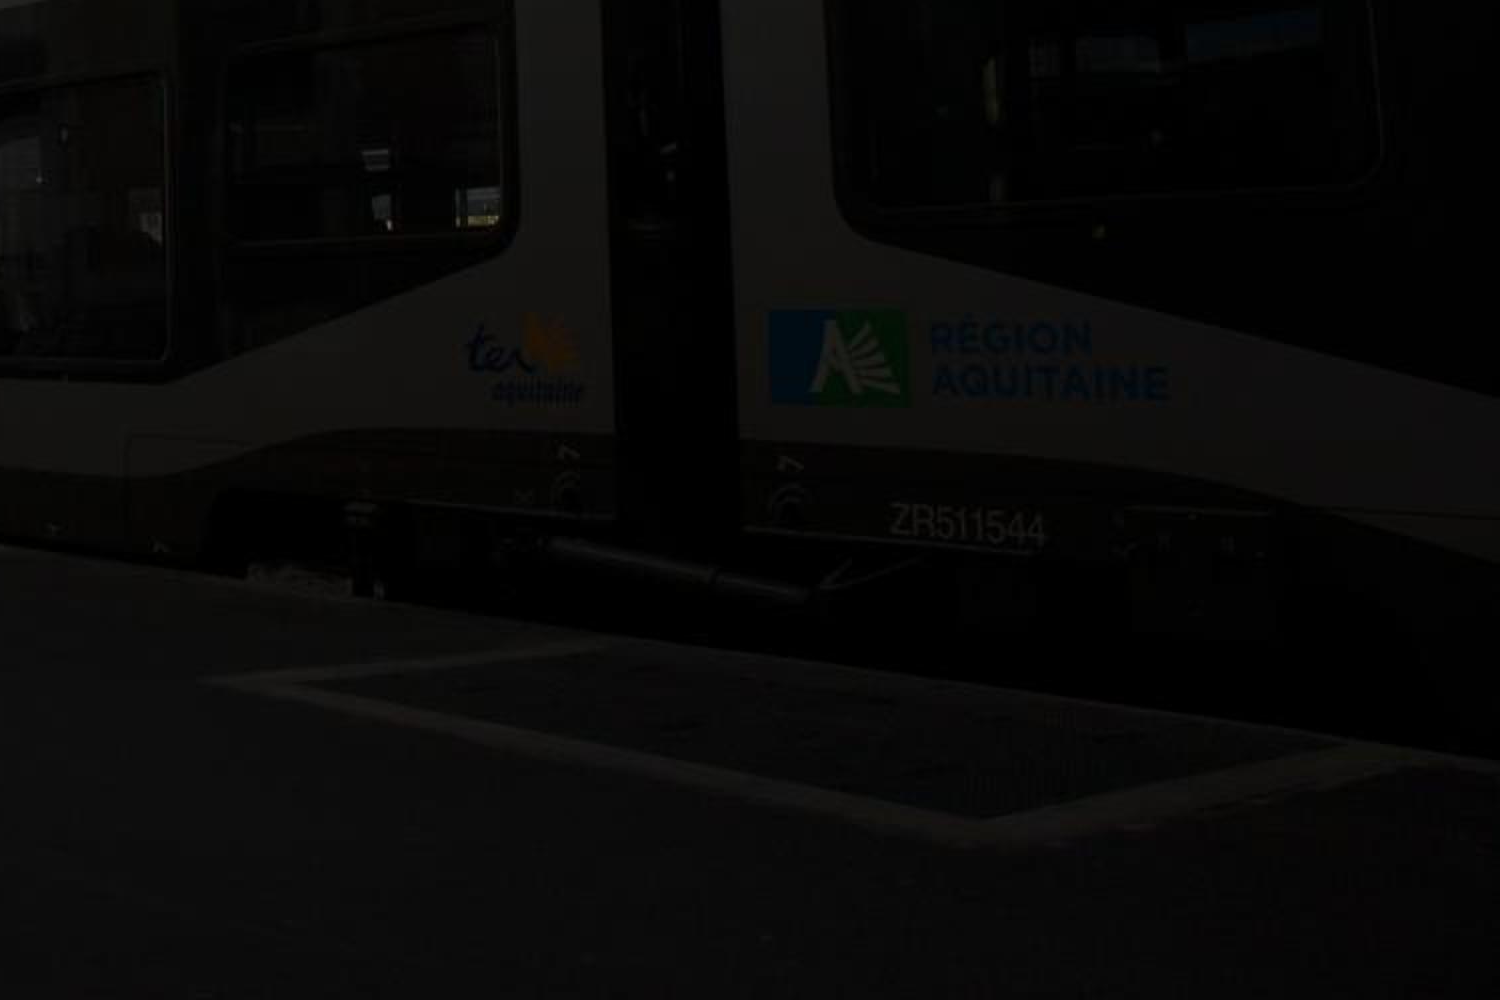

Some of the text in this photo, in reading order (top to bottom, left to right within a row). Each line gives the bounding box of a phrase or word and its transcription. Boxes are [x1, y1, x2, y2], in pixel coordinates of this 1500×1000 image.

[931, 313, 1092, 356] RÉGION
[931, 363, 1169, 404] AQUITAINE
[887, 499, 1048, 547] ZR511544
